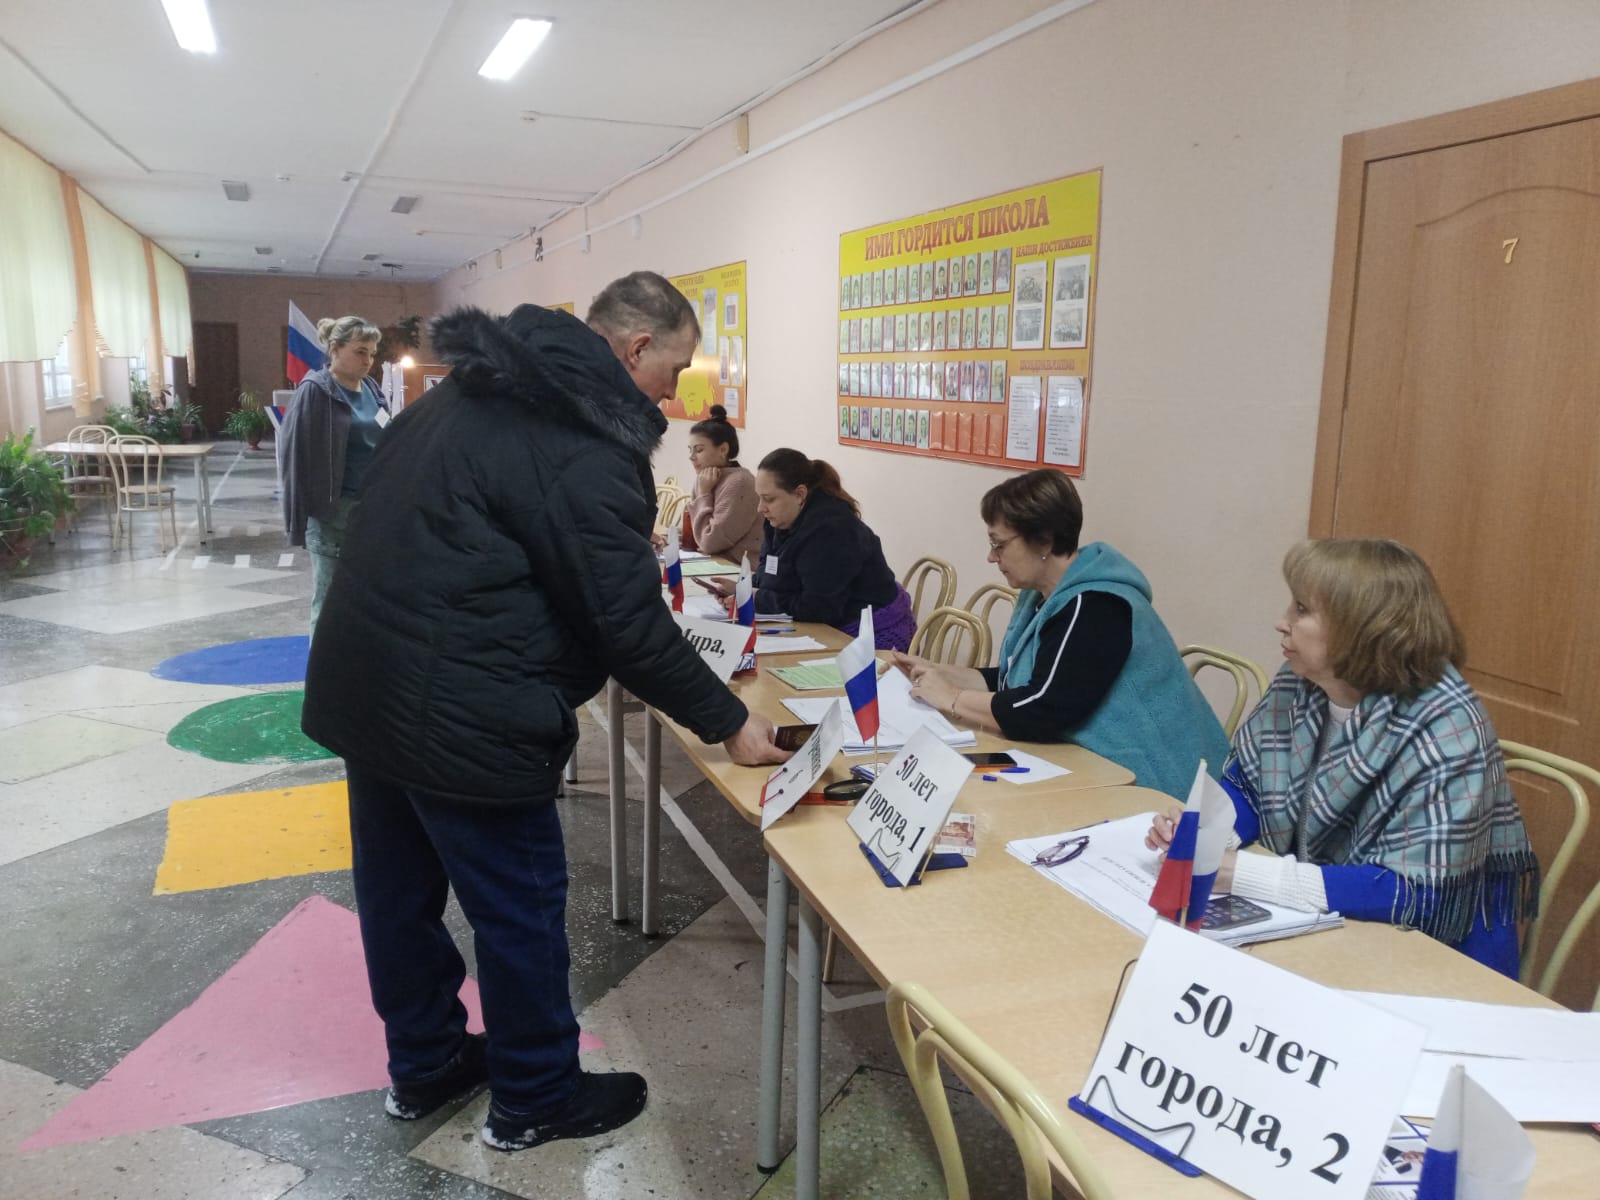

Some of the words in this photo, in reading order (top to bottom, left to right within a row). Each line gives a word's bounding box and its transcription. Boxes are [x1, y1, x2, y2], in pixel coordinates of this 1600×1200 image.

[864, 230, 894, 262] ИМИ
[896, 213, 975, 256] ГОРДИТСЯ
[977, 195, 1050, 239] ШКОЛА
[1502, 237, 1520, 264] 7
[895, 754, 919, 782] 50
[908, 772, 939, 803] лет
[864, 788, 909, 847] города,
[907, 826, 926, 854] 1
[1173, 982, 1233, 1039] 50
[1239, 1024, 1339, 1088] лет
[1114, 1041, 1294, 1169] города,
[1309, 1131, 1351, 1184] 2
